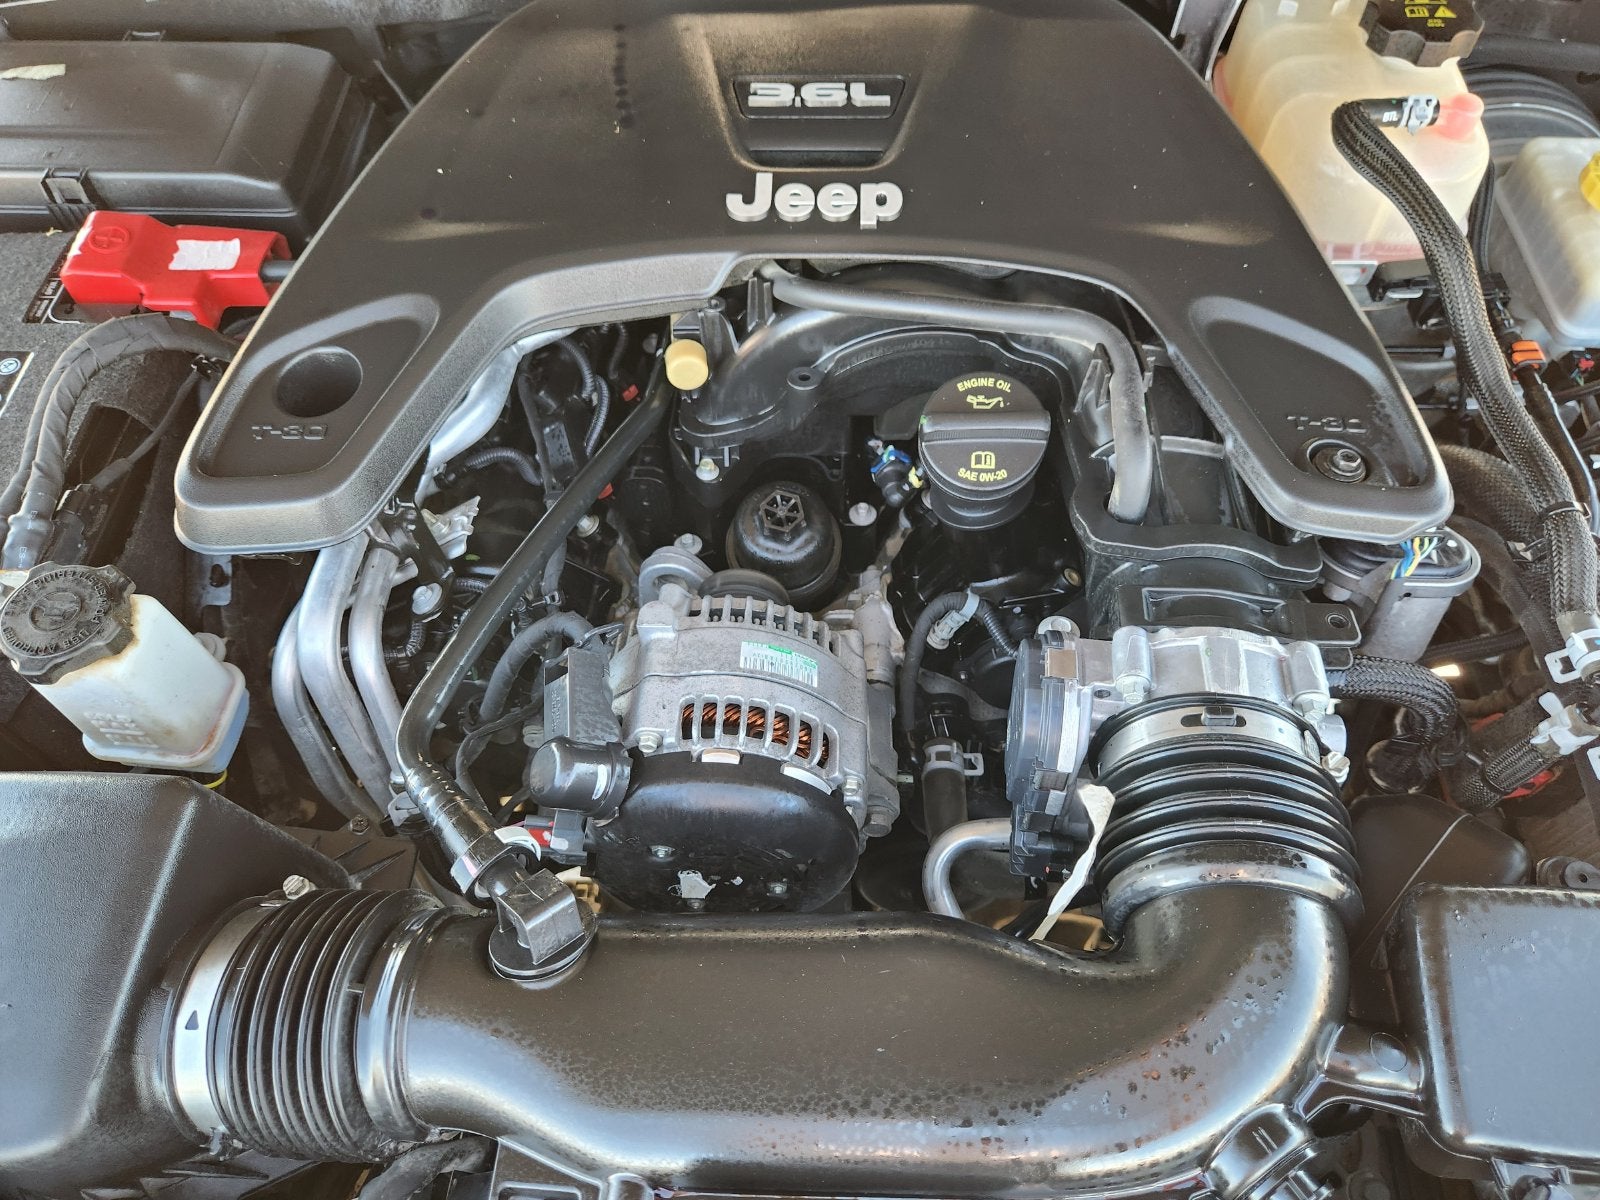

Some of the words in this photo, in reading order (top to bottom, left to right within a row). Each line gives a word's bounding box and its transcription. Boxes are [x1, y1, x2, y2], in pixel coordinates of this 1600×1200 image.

[725, 172, 904, 230] Jeep
[956, 377, 996, 393] ENGINE
[995, 378, 1012, 393] OIL
[957, 467, 979, 482] SAE
[978, 468, 1008, 482] 0W-20
